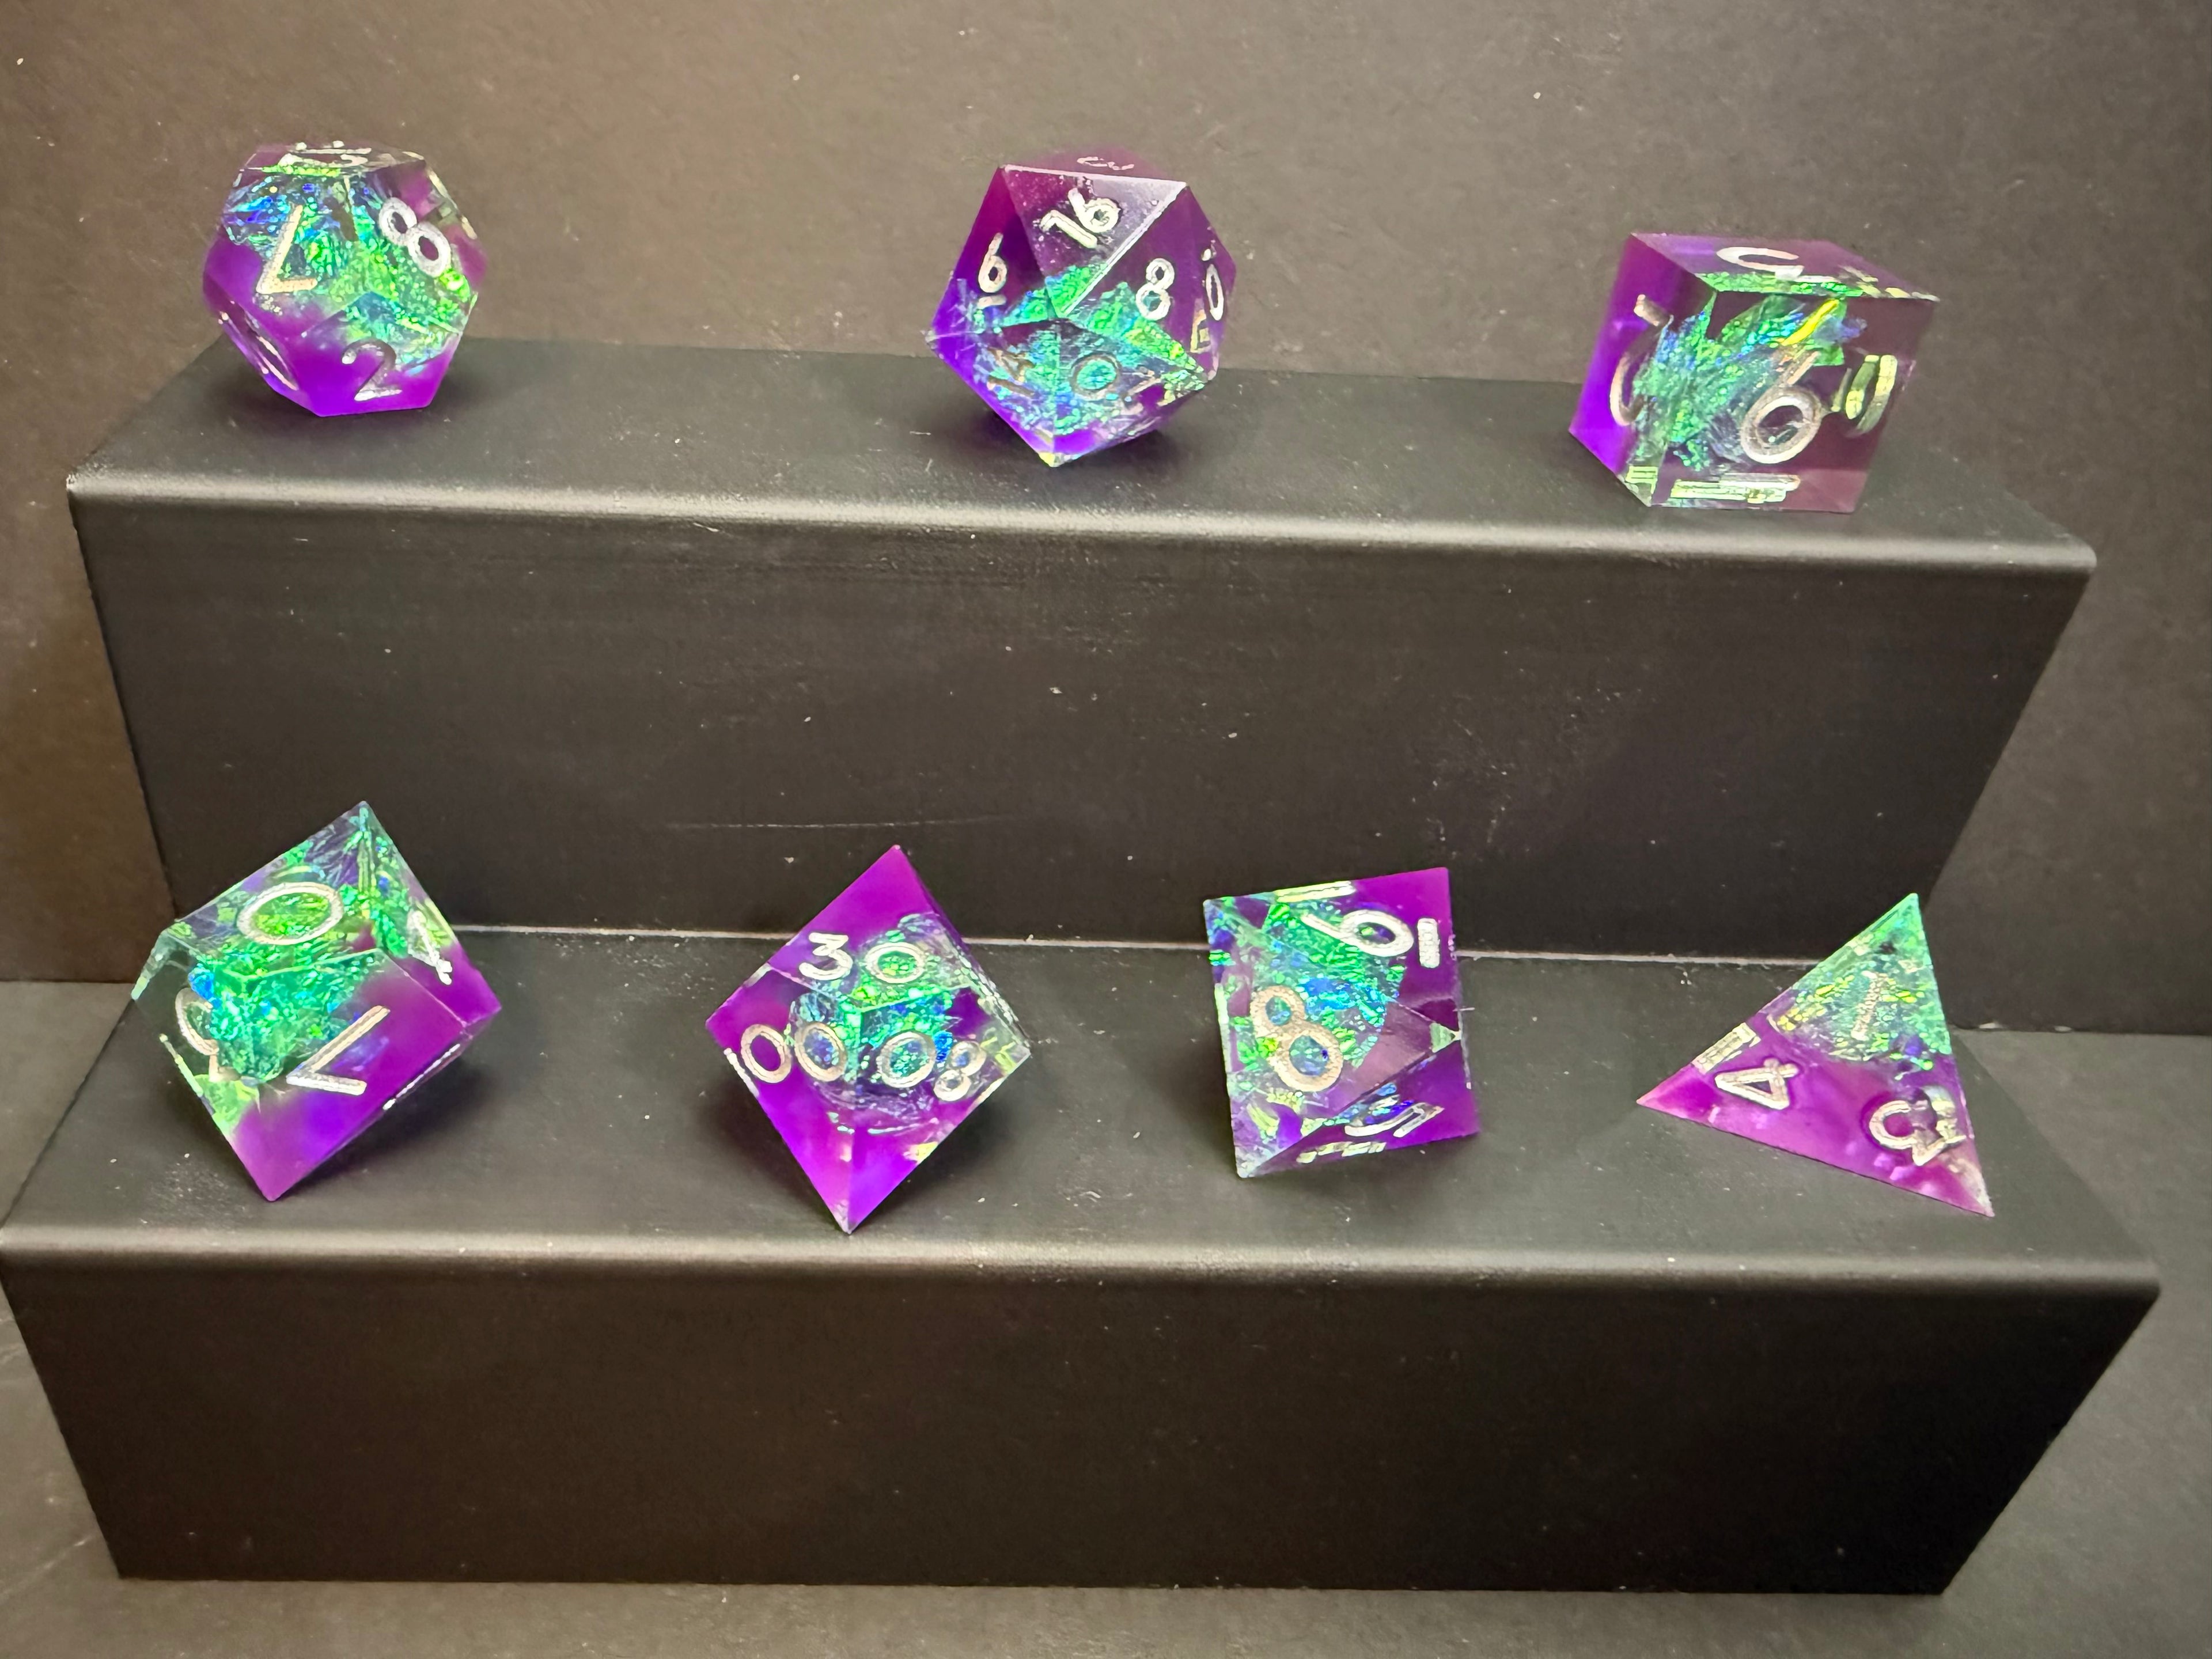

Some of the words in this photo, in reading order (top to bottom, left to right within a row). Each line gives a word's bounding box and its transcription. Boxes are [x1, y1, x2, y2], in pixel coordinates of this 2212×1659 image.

[255, 204, 319, 294] 7
[378, 196, 452, 278] 8
[1039, 187, 1121, 249] 16
[978, 232, 1007, 293] 6
[1135, 257, 1175, 321] 8
[342, 338, 403, 401] 2
[1740, 350, 1822, 464] 6
[237, 881, 346, 946] 0
[1300, 908, 1415, 957] 6
[798, 931, 925, 984] 30
[286, 1005, 392, 1096] 7
[741, 1023, 847, 1084] 00
[1249, 984, 1344, 1093] 8
[1714, 1057, 1800, 1111] 4
